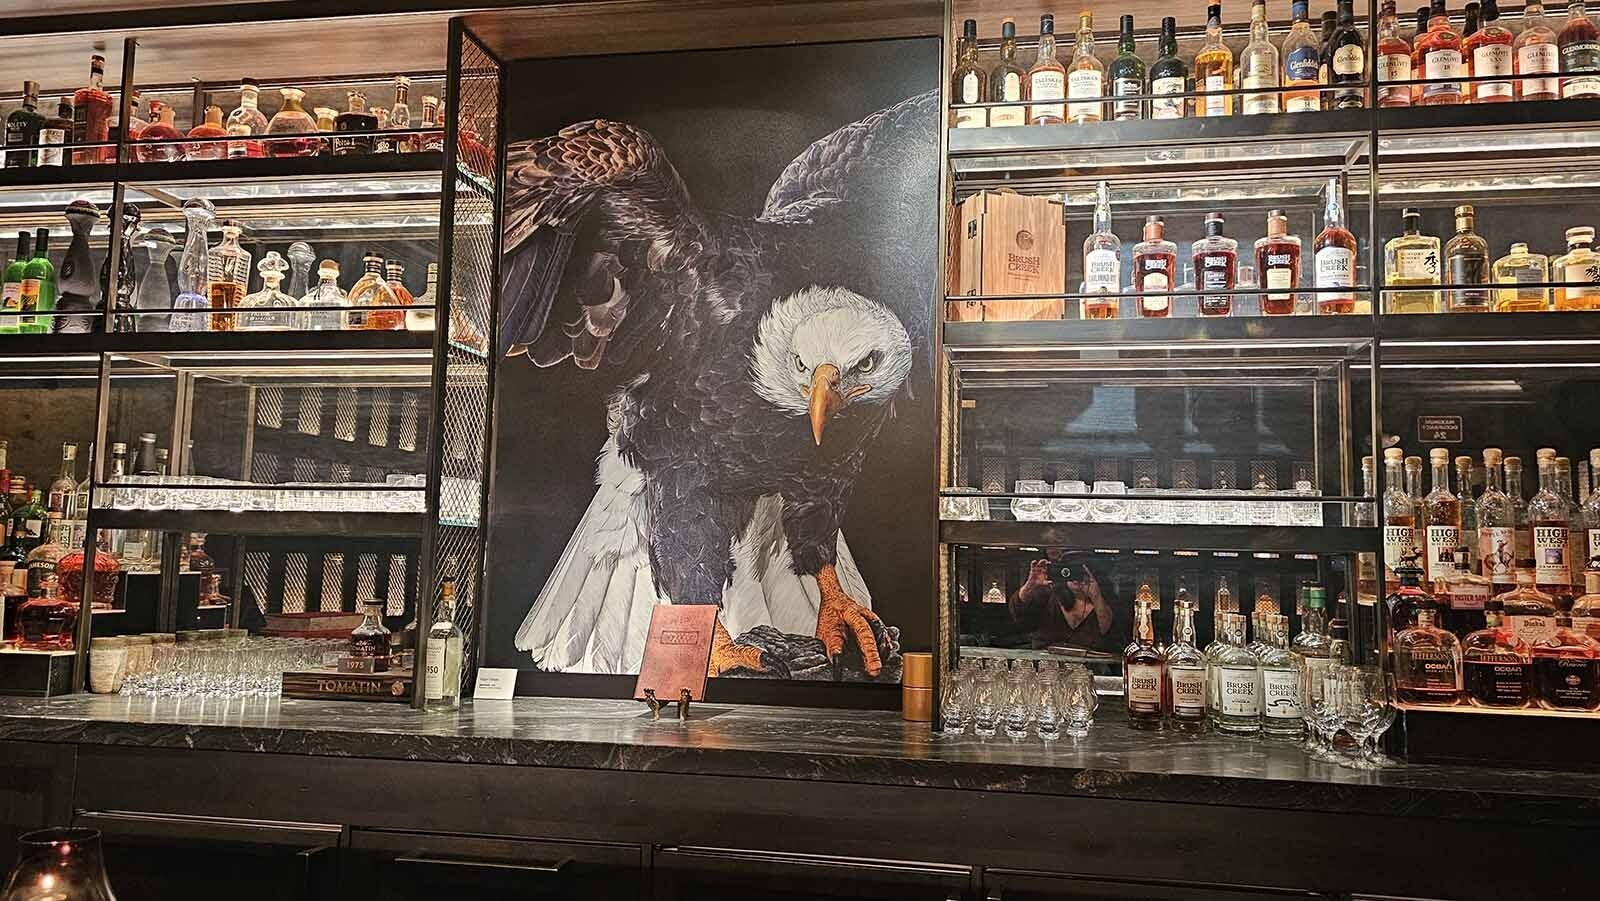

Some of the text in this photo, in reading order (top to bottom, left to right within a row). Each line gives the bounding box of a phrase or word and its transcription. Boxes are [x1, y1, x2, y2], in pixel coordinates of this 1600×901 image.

[1008, 253, 1041, 266] BRUSH
[1008, 262, 1040, 275] CREEK
[1320, 264, 1349, 272] CREEK
[1386, 528, 1414, 537] HIGH
[1431, 528, 1458, 537] HIGH
[1536, 528, 1568, 538] HIGH
[317, 680, 382, 693] TOMATIN
[1131, 683, 1157, 691] CREEK
[1176, 681, 1202, 689] BRUSH
[1226, 681, 1254, 689] BRUSH
[1269, 682, 1297, 690] BRUSH
[1176, 687, 1202, 695] CREEK
[1226, 688, 1254, 696] CREEK
